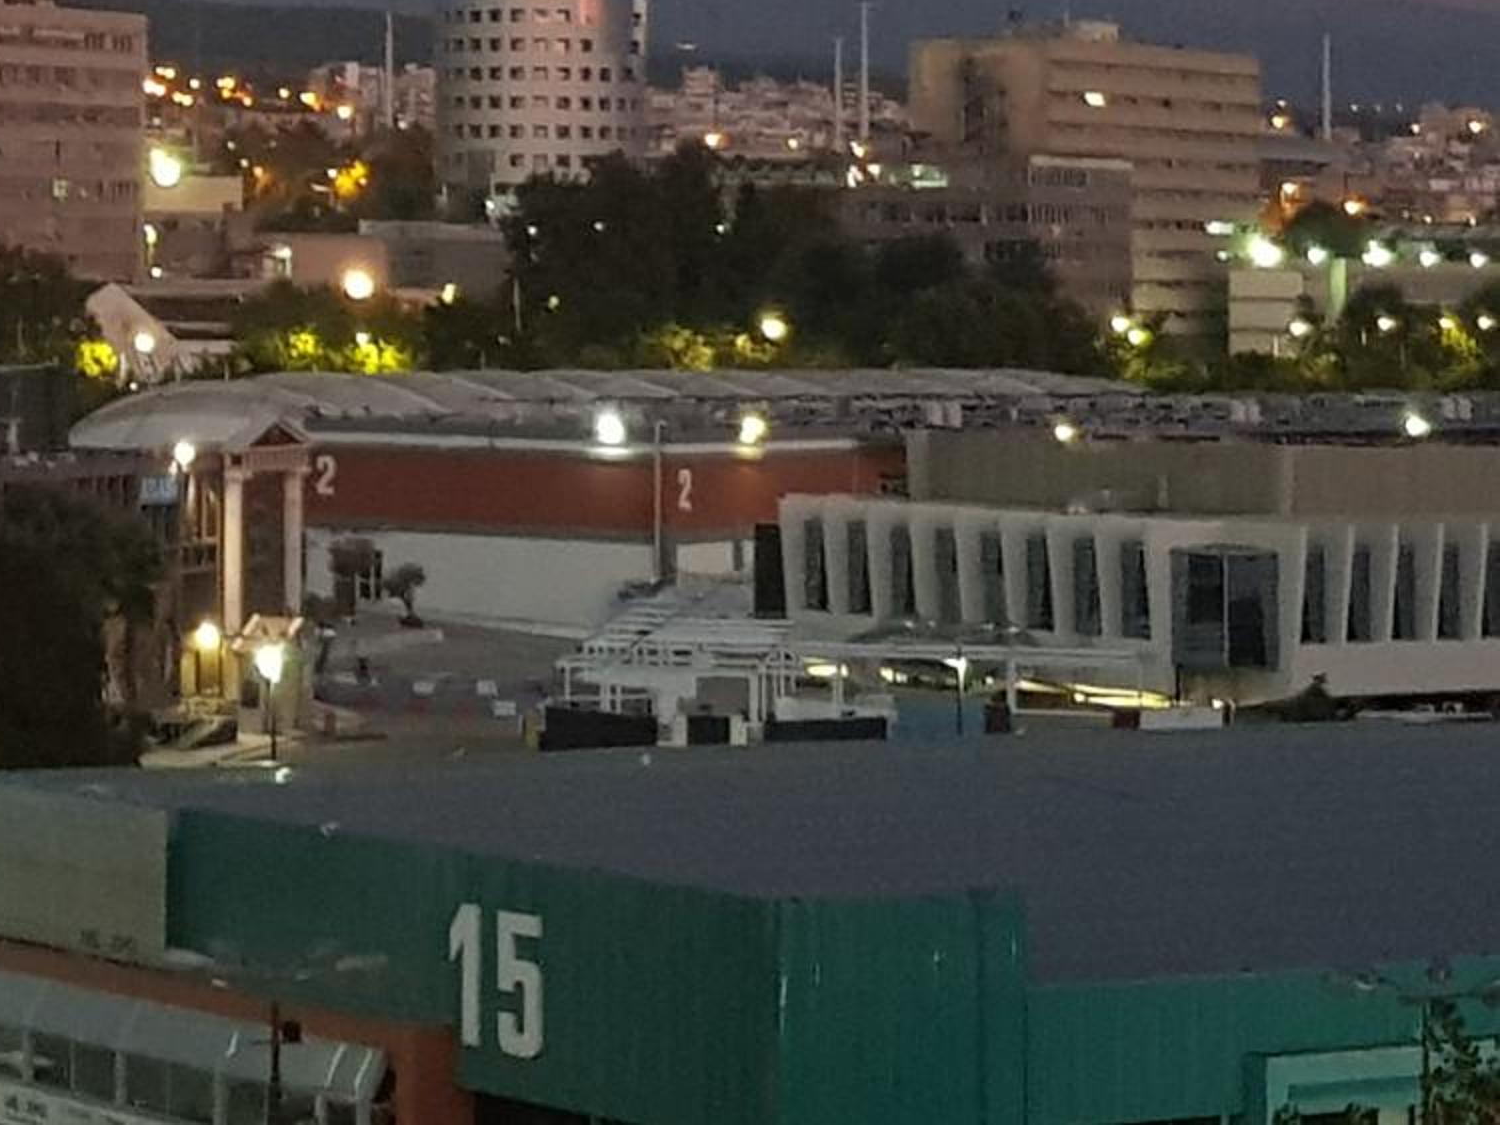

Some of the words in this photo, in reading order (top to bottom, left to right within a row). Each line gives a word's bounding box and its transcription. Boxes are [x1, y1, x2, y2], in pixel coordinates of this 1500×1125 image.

[315, 455, 336, 495] 2
[678, 469, 692, 511] 2
[449, 903, 544, 1059] 15
